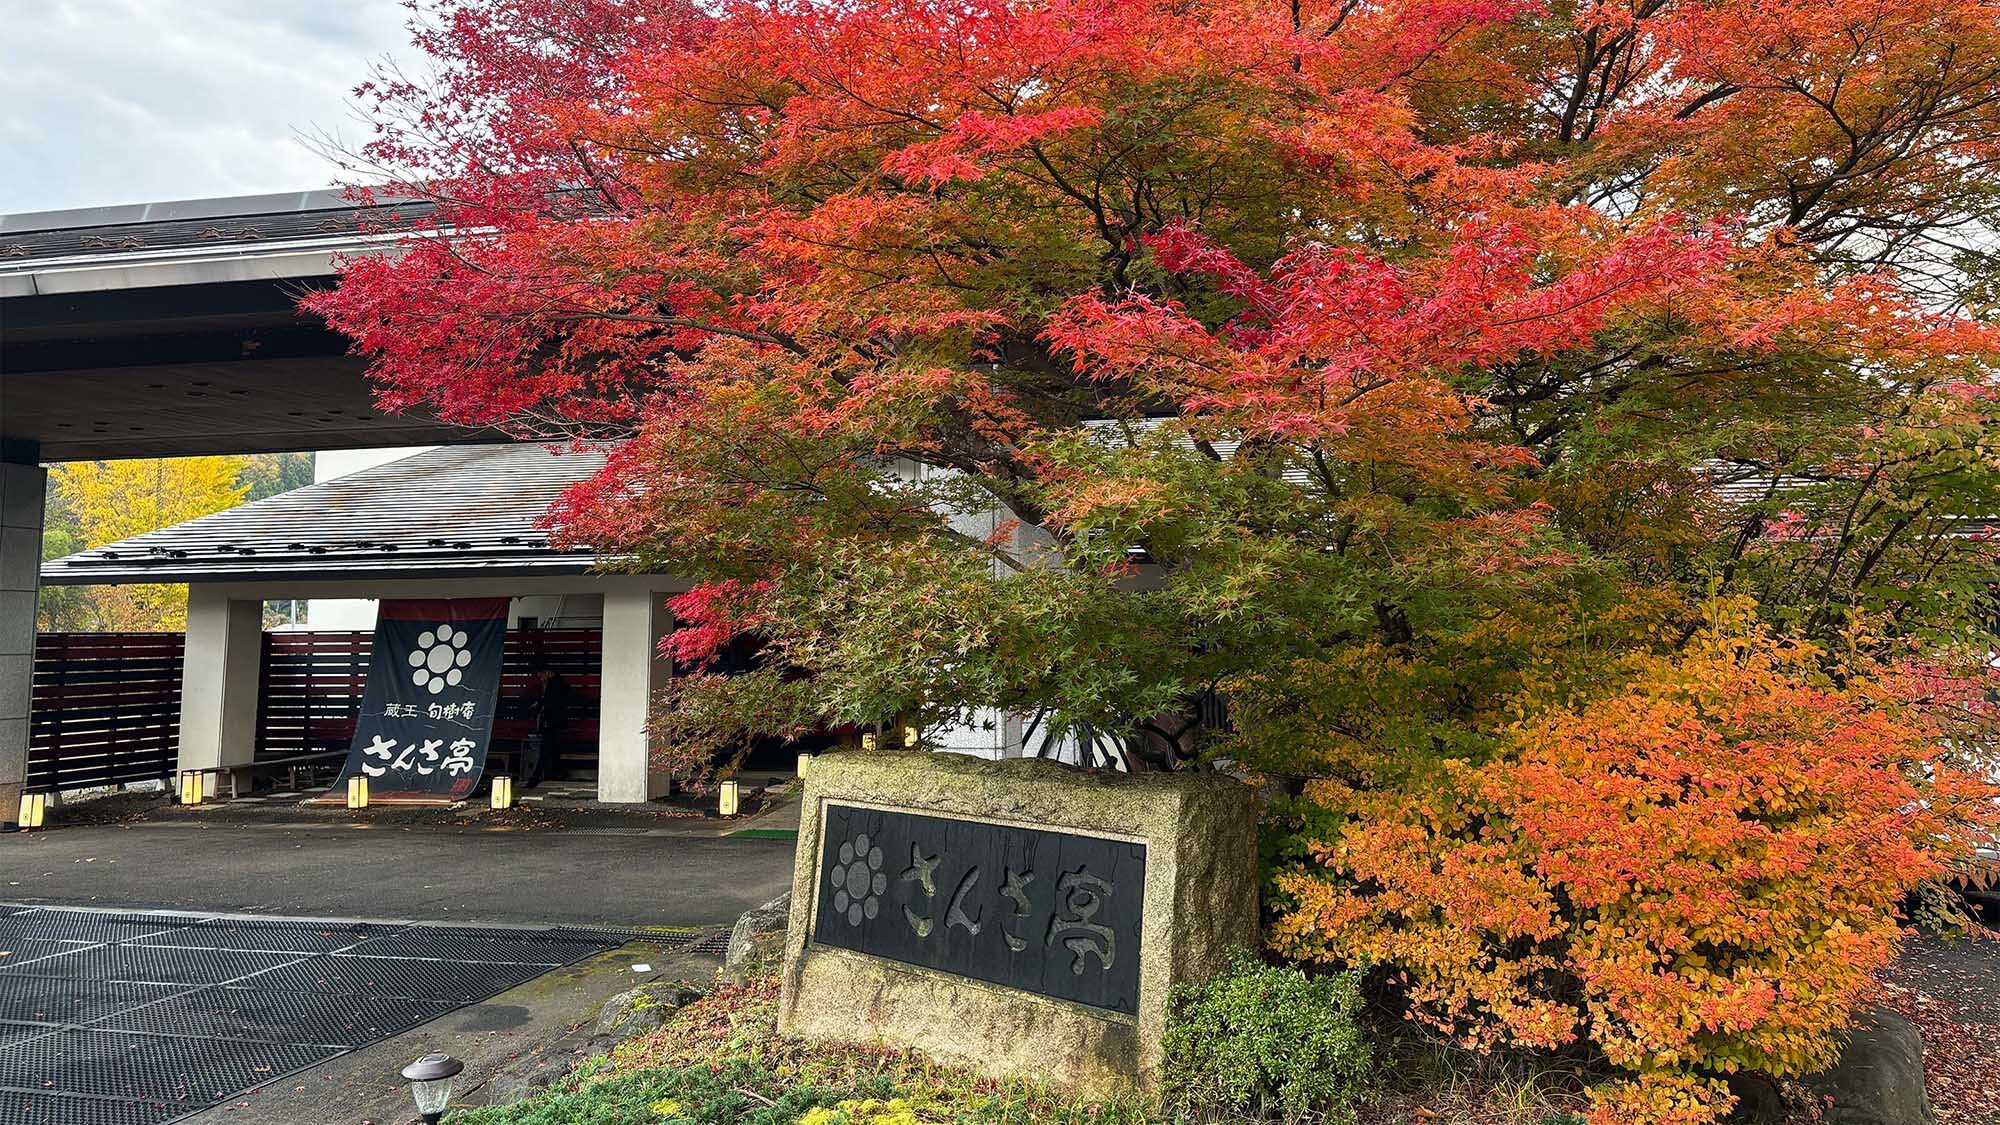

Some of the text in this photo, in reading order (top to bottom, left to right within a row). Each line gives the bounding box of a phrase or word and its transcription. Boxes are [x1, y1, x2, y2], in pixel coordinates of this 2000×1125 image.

[384, 703, 418, 718] 蔵王
[361, 735, 476, 777] さんさ亭
[900, 842, 1116, 975] さんさ亭
